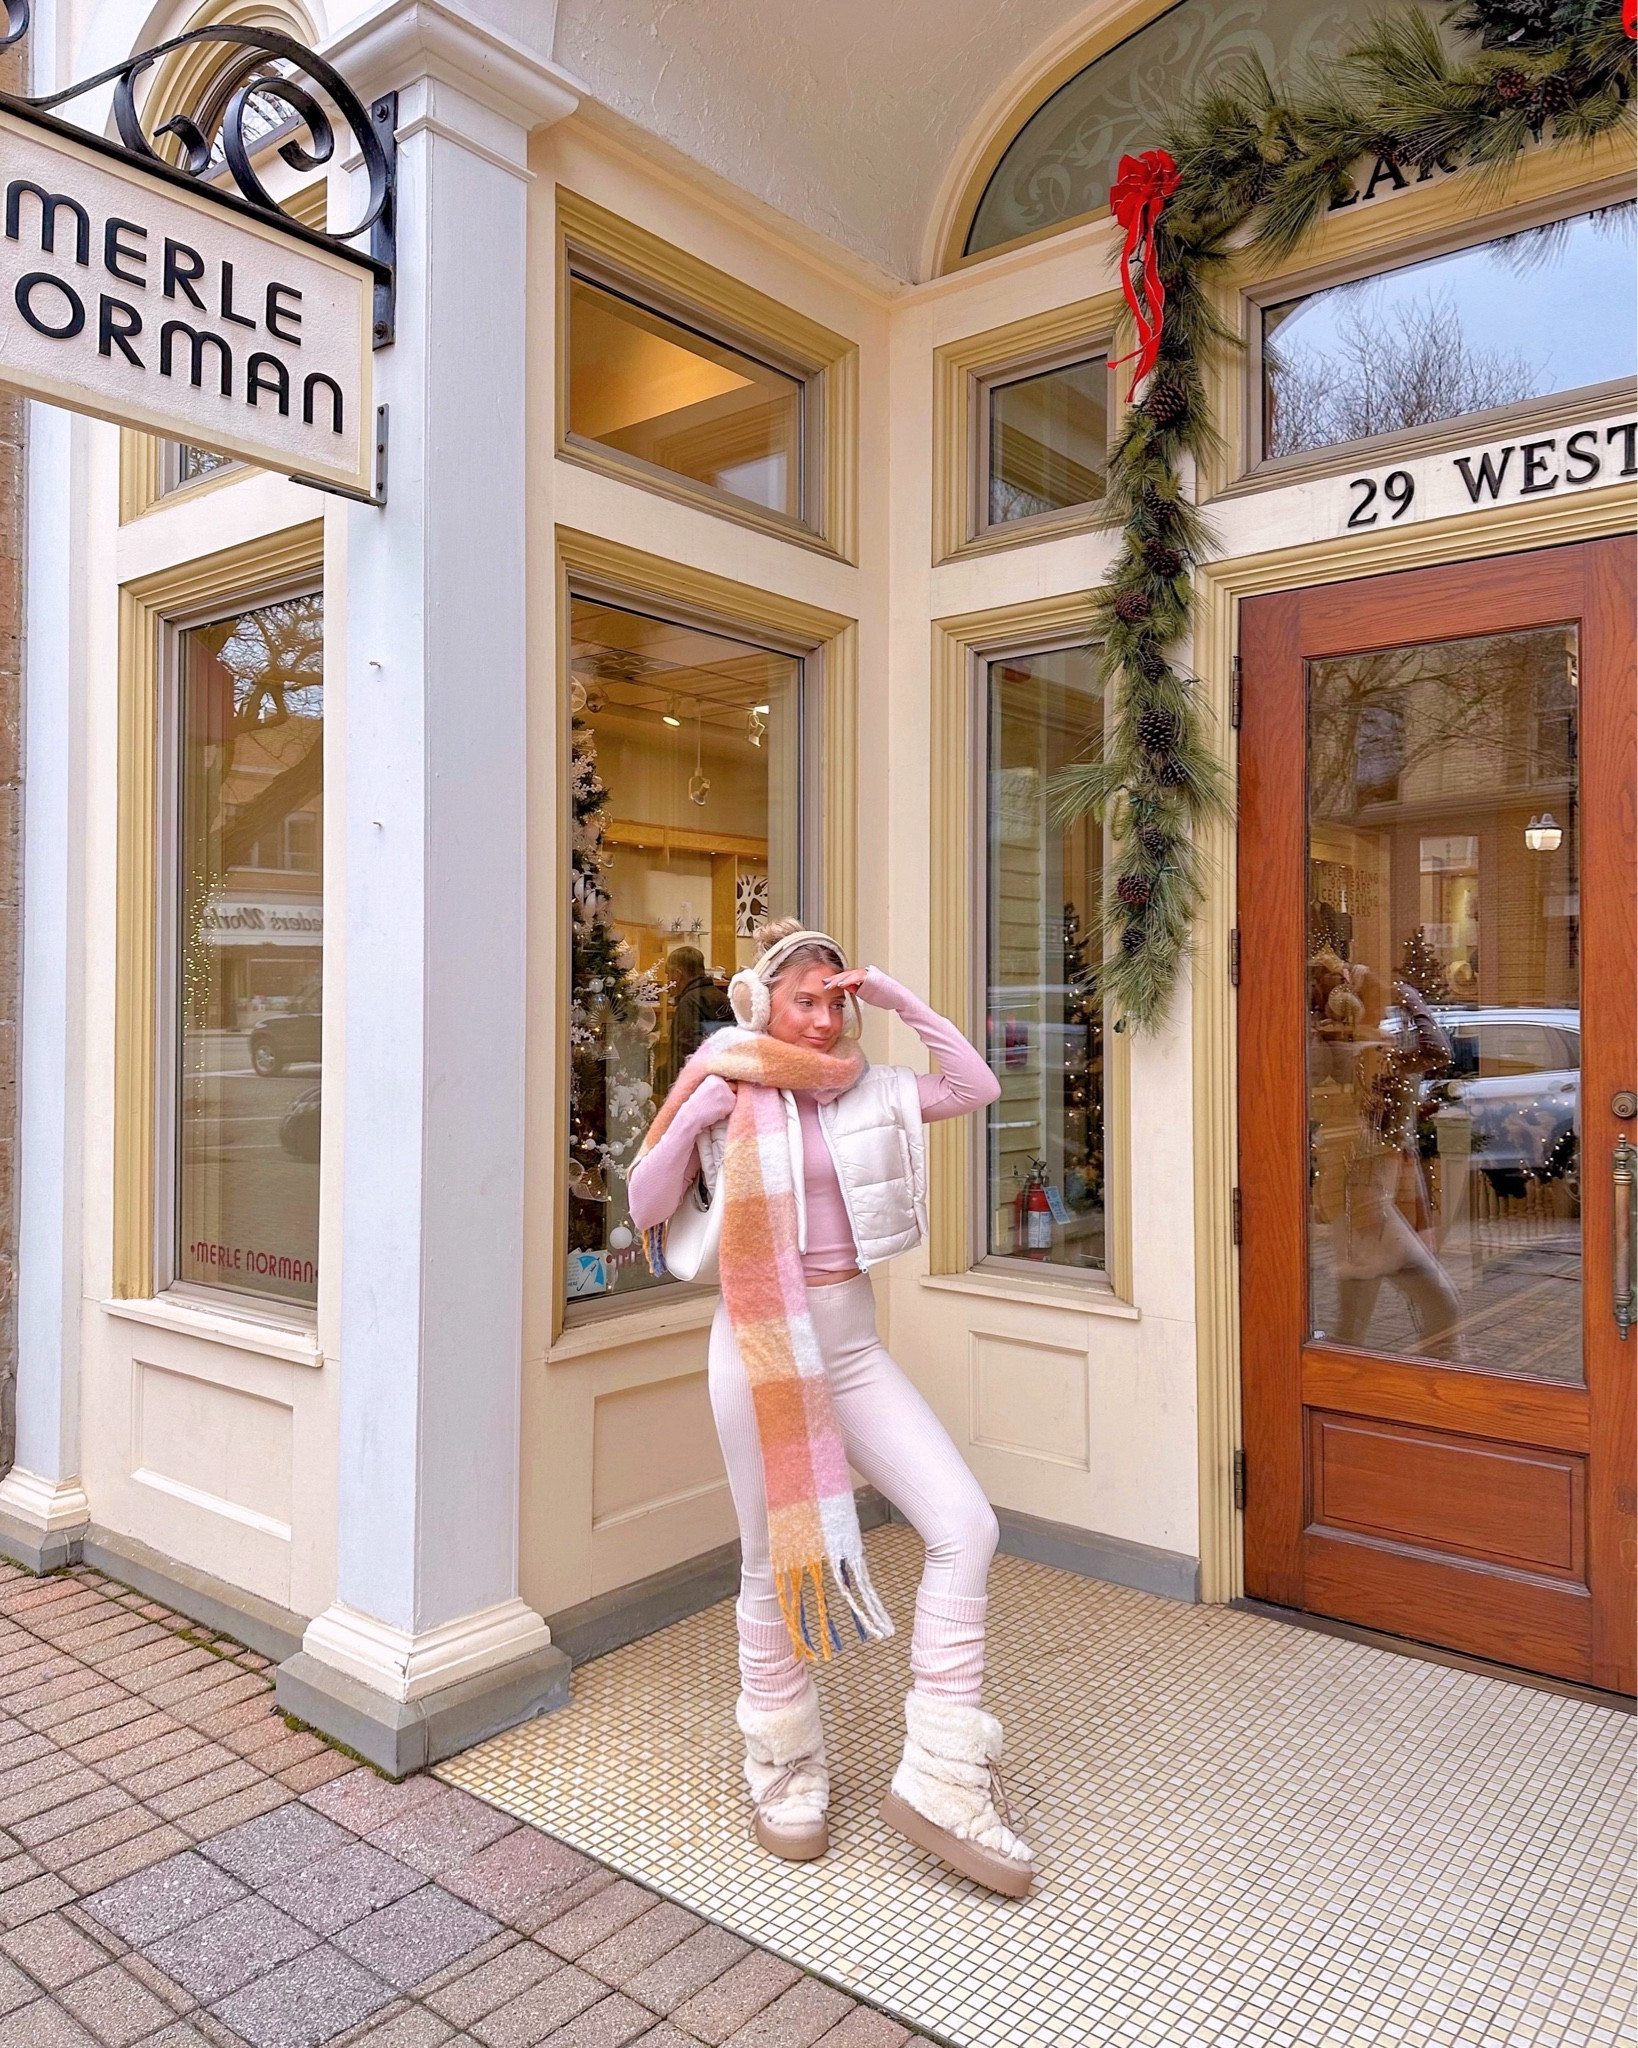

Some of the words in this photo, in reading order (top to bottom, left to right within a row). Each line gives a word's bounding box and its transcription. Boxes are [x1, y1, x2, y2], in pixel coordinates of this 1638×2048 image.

[6, 179, 303, 347] MERLE
[1347, 470, 1416, 528] 29
[1453, 422, 1638, 504] WEST
[196, 1241, 241, 1270] MERLE
[246, 1250, 313, 1284] NORMAN
